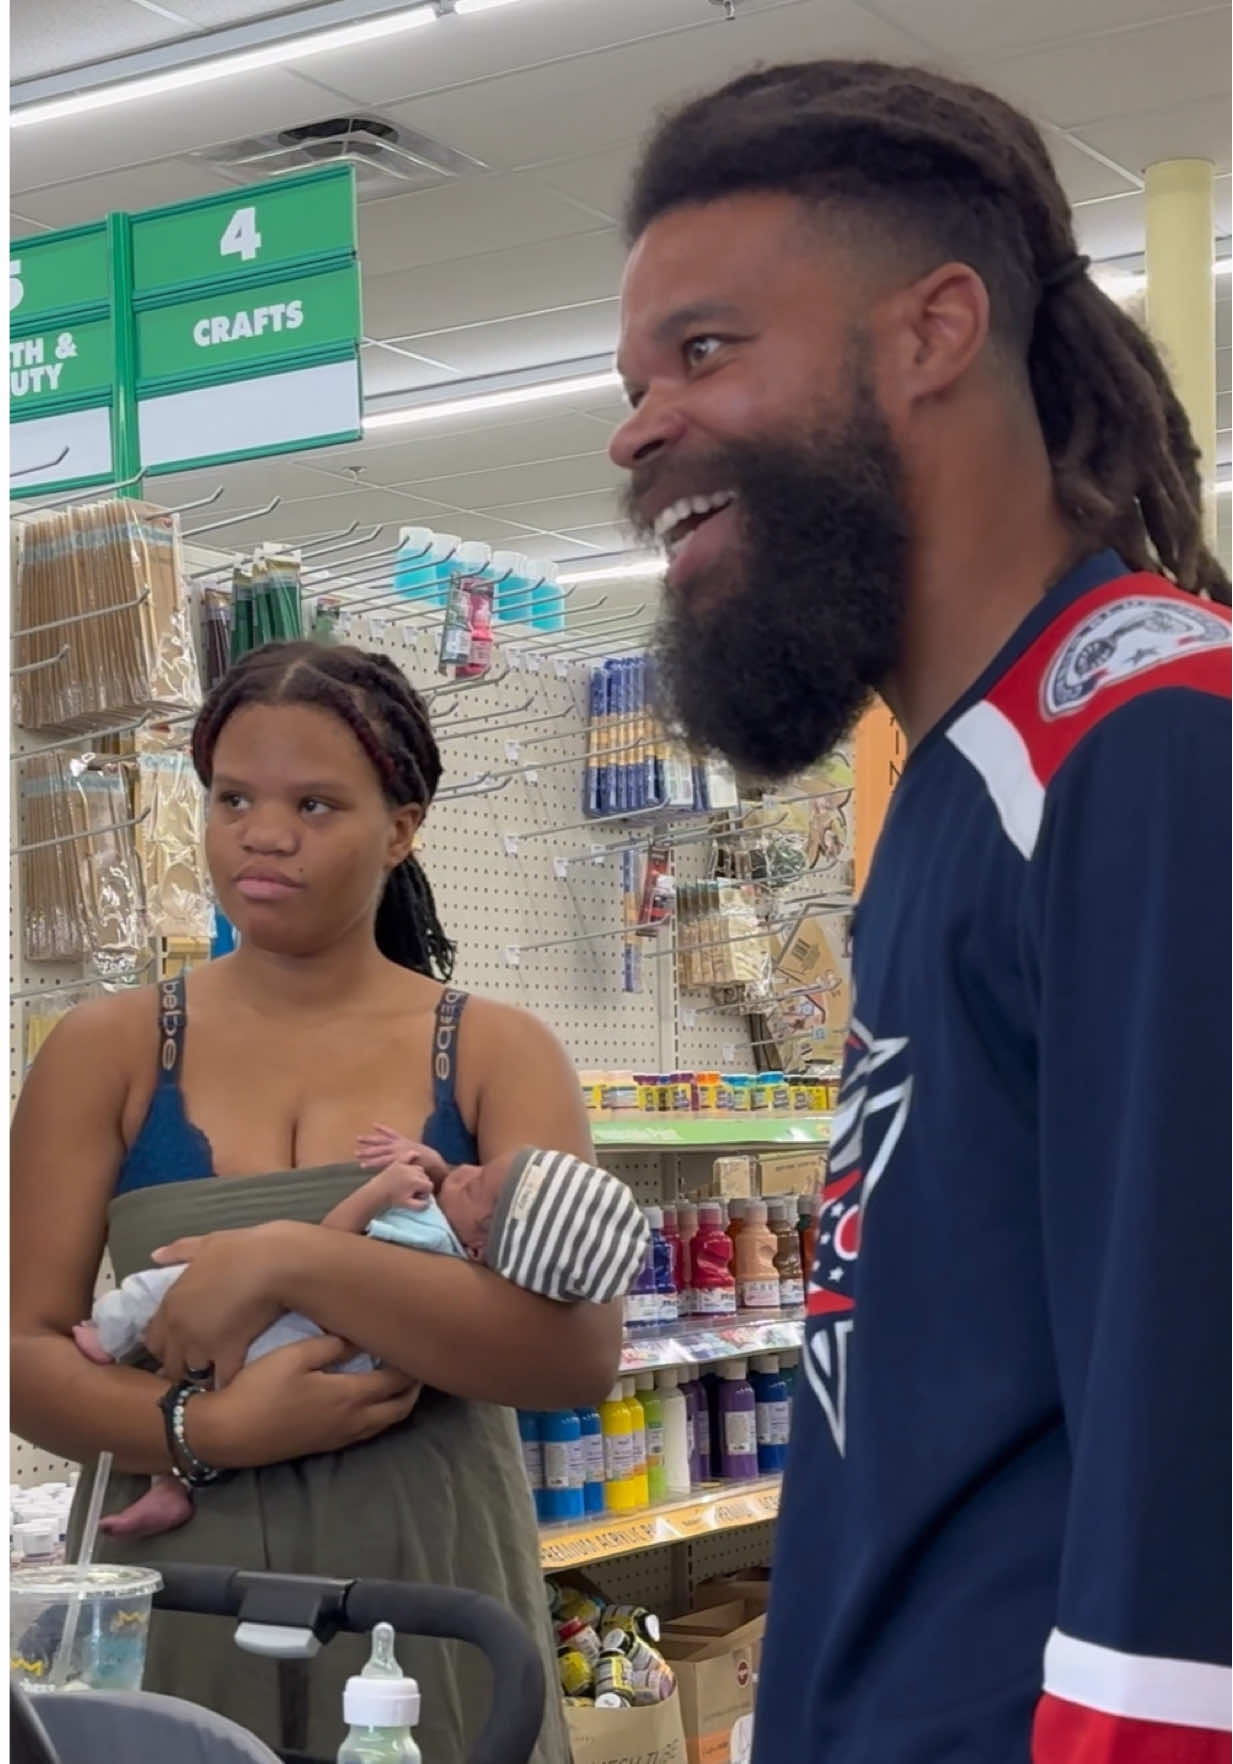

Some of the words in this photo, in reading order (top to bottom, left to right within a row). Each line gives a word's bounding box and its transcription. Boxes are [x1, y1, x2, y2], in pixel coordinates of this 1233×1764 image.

[220, 207, 261, 261] 4
[193, 300, 304, 347] CRAFTS
[55, 332, 78, 359] &
[10, 362, 63, 396] UTY
